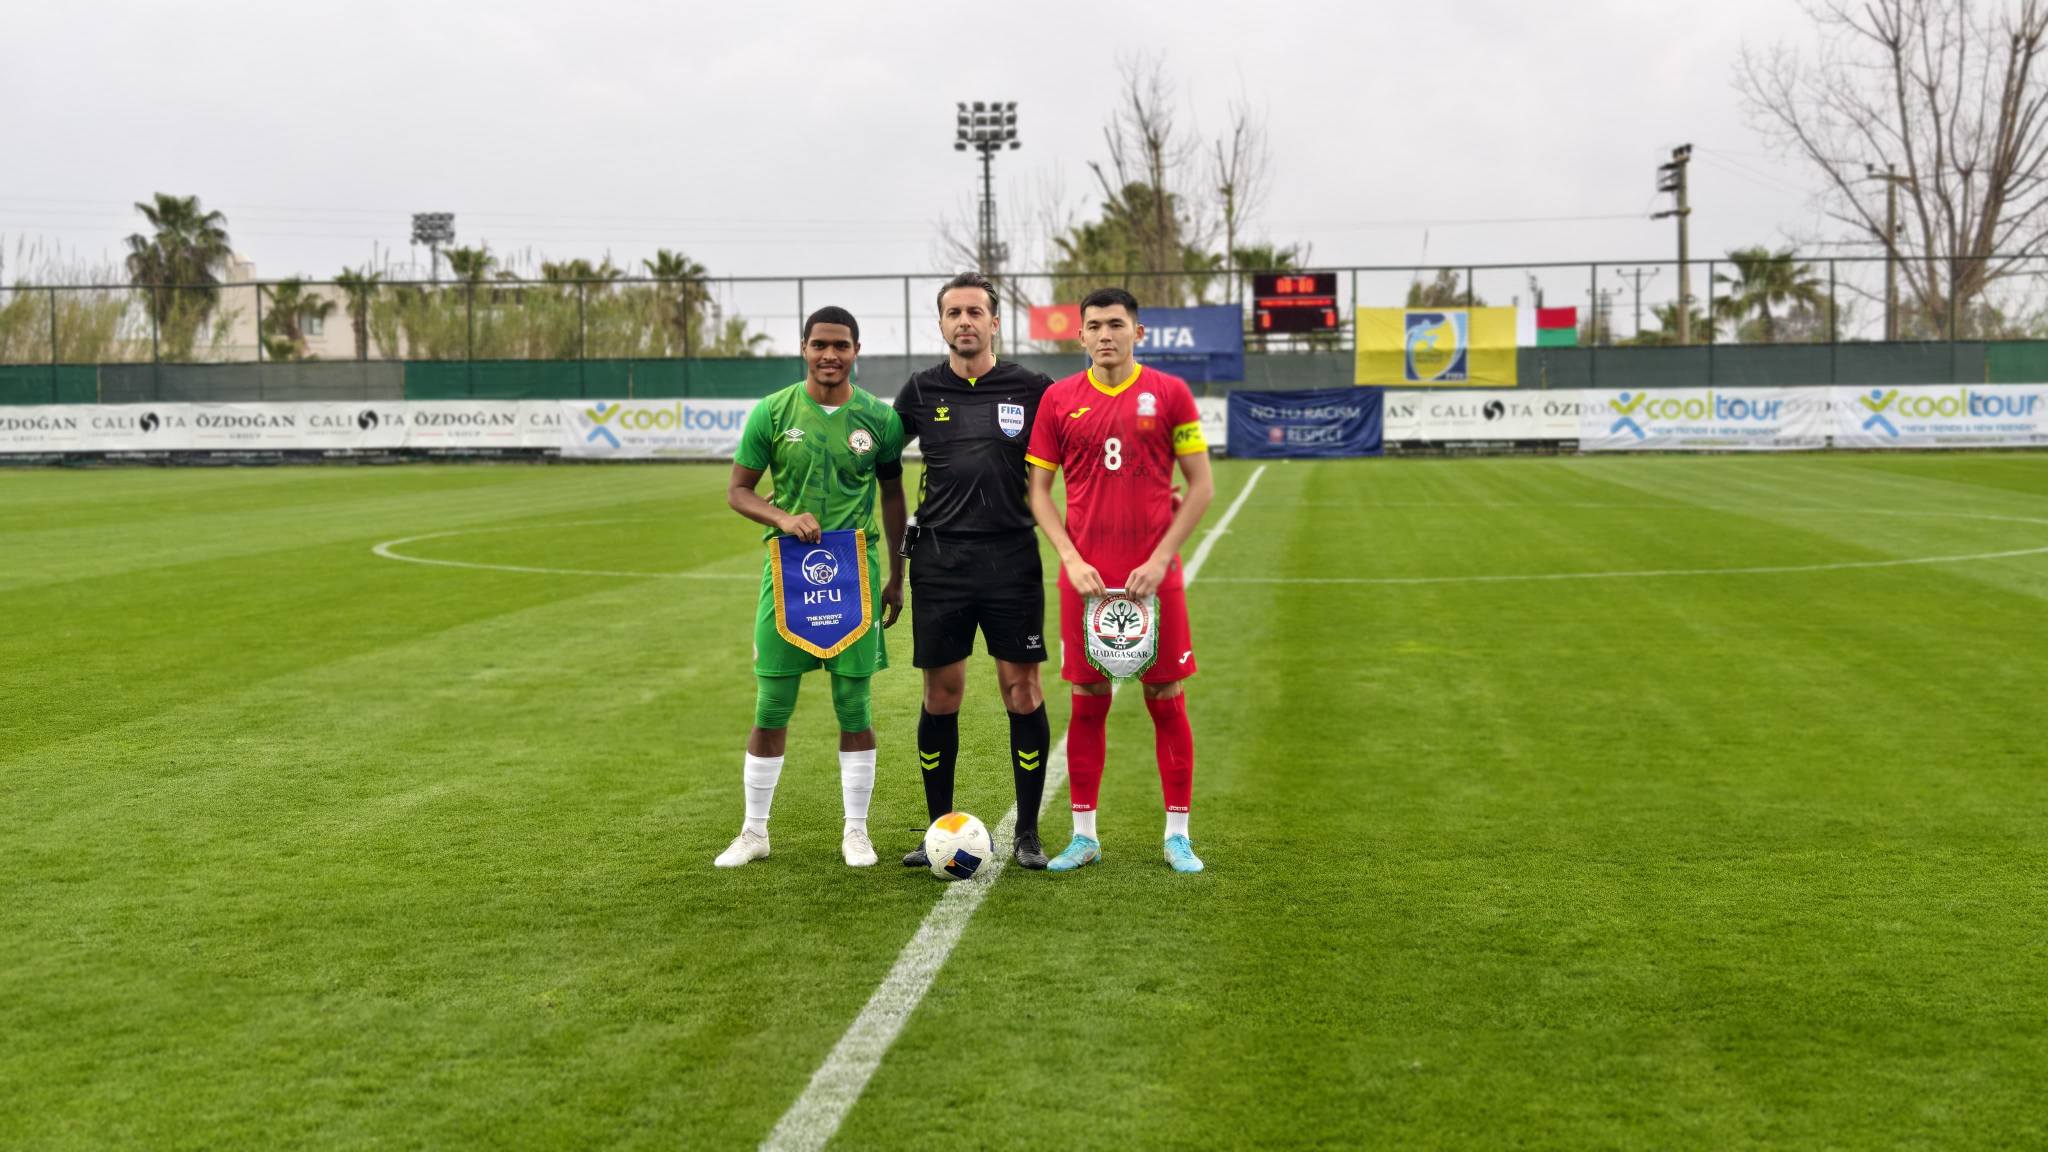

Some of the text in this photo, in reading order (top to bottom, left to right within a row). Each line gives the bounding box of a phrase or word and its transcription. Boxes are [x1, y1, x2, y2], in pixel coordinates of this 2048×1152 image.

[1137, 327, 1195, 347] FIFA
[1001, 405, 1022, 415] FIFA
[1646, 390, 1783, 421] cooltour
[1899, 388, 2038, 417] cooltour
[414, 410, 516, 426] ÖZDOĞAN
[619, 401, 746, 431] cooltour
[1251, 406, 1276, 418] NO
[195, 413, 296, 428] ÖZDOĞAN
[1287, 429, 1343, 442] RESPECT
[1104, 437, 1122, 471] 8
[804, 588, 842, 605] KFU
[811, 619, 840, 627] REPUBLIC
[1092, 649, 1148, 658] MADAGASCAR
